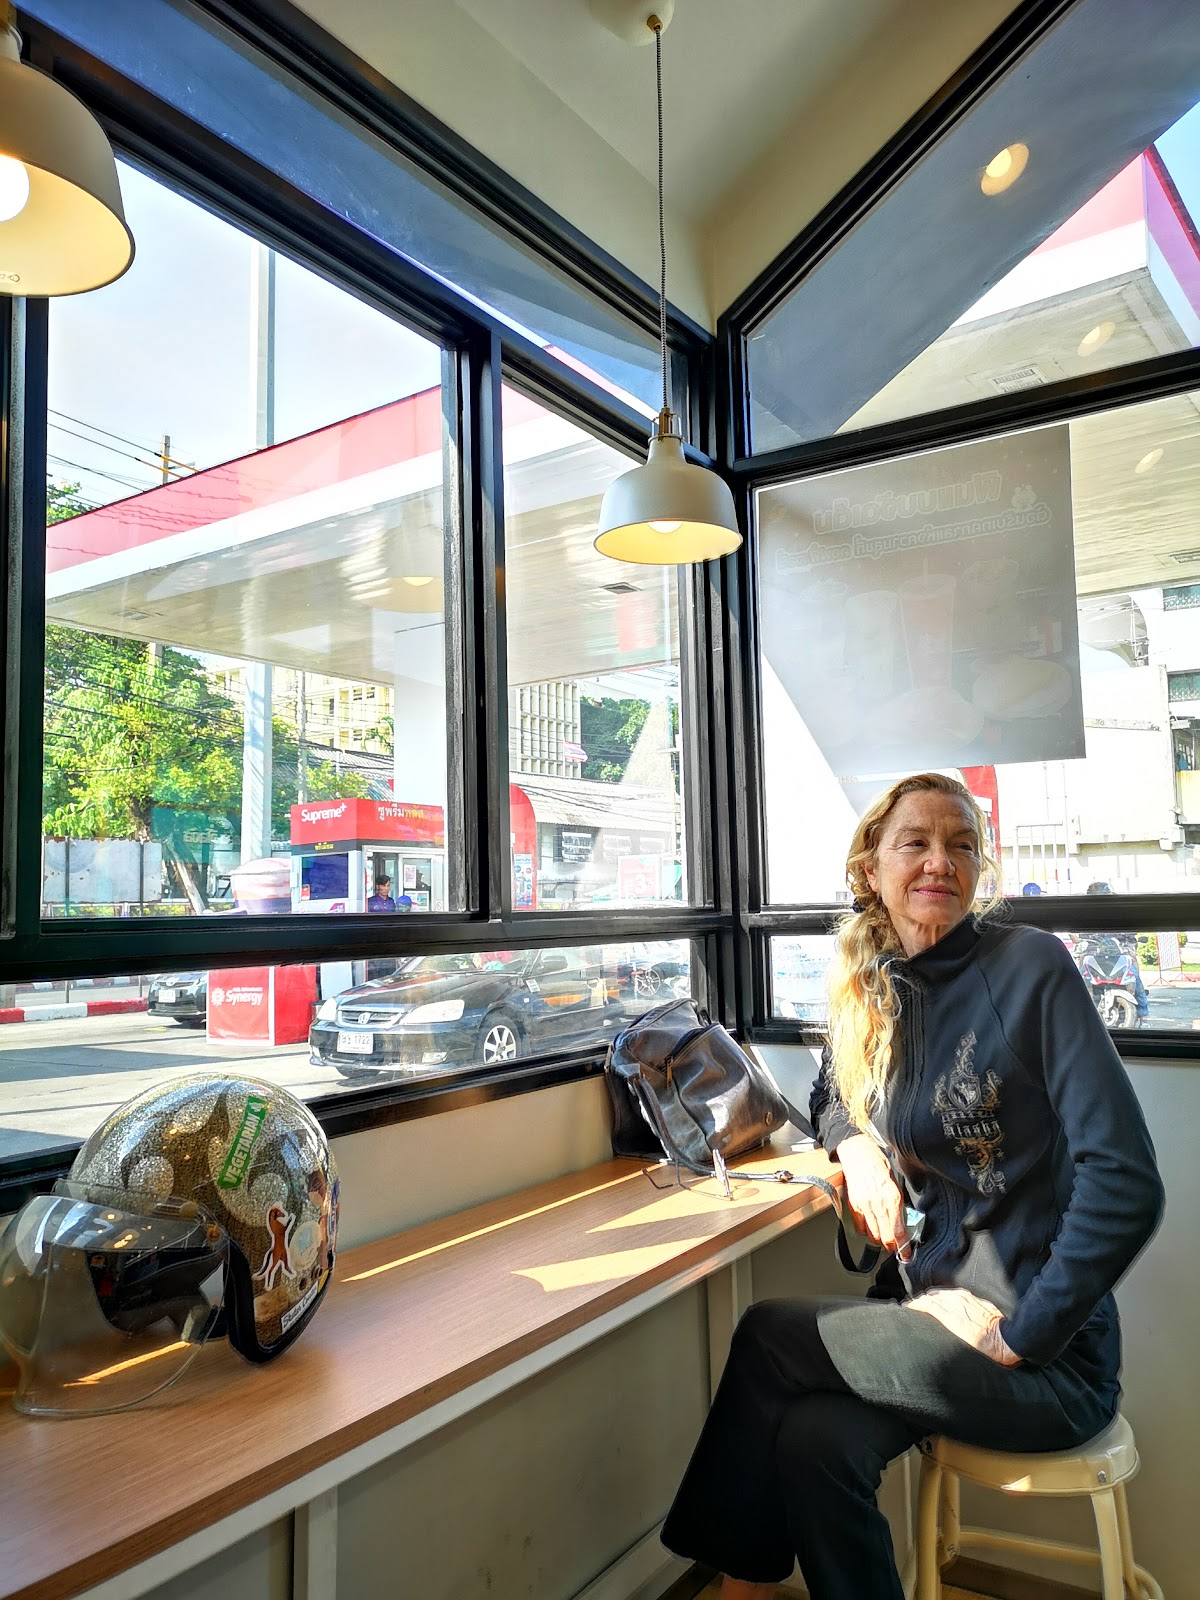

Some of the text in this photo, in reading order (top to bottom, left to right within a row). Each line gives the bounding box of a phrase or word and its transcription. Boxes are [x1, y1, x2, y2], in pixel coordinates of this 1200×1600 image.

[301, 802, 347, 824] Supreme+
[226, 989, 264, 1006] Synergy
[225, 1113, 259, 1185] VEGETARIAN
